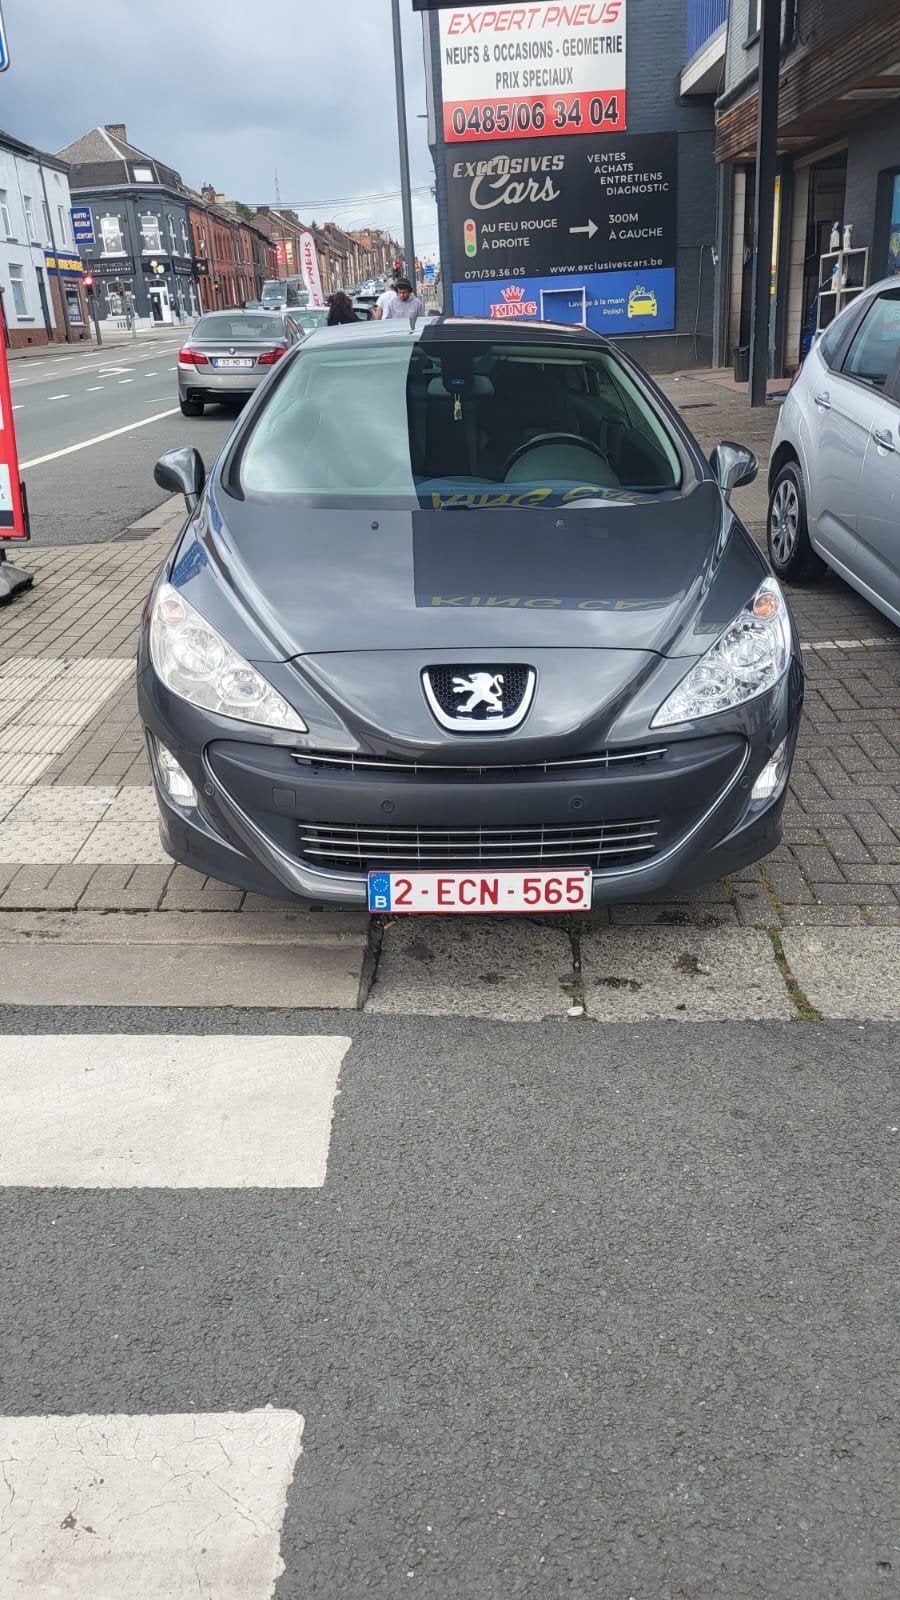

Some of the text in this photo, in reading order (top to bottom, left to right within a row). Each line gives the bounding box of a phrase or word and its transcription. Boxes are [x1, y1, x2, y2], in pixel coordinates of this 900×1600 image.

[447, 2, 622, 35] EXPERT PNEUS
[446, 46, 480, 65] NEUFS
[483, 47, 491, 62] &
[493, 40, 553, 62] OCCASIONS
[563, 35, 623, 57] GEOMETRIE
[495, 67, 574, 90] PRIX SPECIAUX
[452, 96, 619, 135] 0485/06 34 04
[452, 154, 565, 178] EXCLUSIVES
[587, 152, 626, 163] VENTES
[594, 163, 634, 174] ACHATS
[469, 155, 560, 210] Cars
[600, 172, 663, 185] ENTRETIENS
[606, 183, 669, 196] DIAGNOSTIC
[481, 218, 558, 233] AU FEU ROUGE
[608, 213, 639, 224] 300M
[608, 227, 663, 241] À GAUCHE
[481, 237, 530, 250] À DROITE
[464, 267, 526, 280] 071/39.36.05
[550, 258, 663, 274] www.exclusivescars.be
[490, 301, 537, 318] KING
[374, 877, 585, 908] B 2-ECN-565
